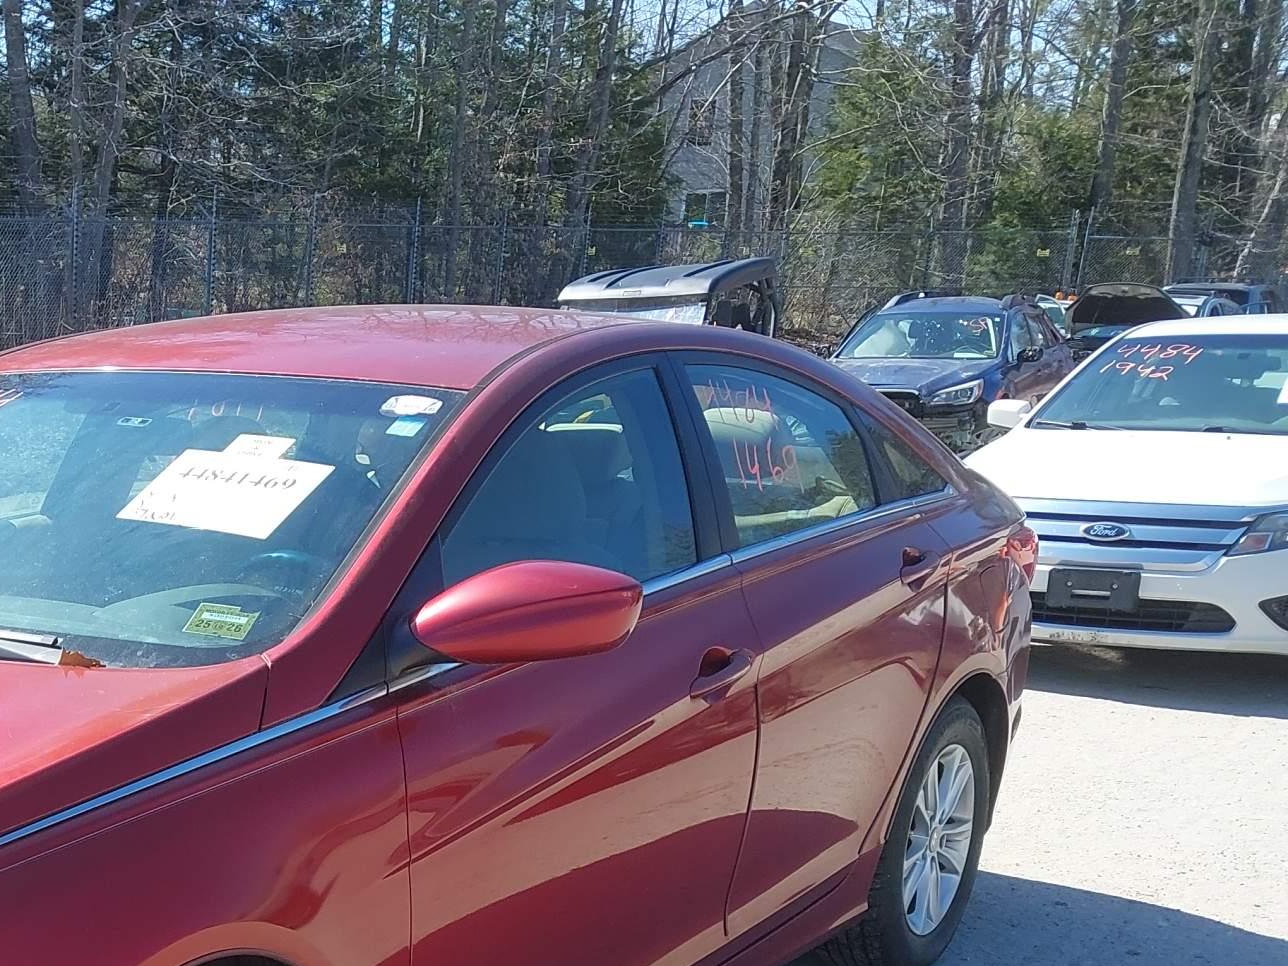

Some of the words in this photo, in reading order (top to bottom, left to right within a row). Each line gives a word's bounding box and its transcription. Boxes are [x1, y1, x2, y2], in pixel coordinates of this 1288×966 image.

[1117, 343, 1204, 365] 4484
[1099, 359, 1174, 381] 1942
[733, 437, 805, 493] 1469
[1089, 524, 1120, 537] Ford
[194, 619, 213, 629] 25
[226, 622, 244, 633] 26
